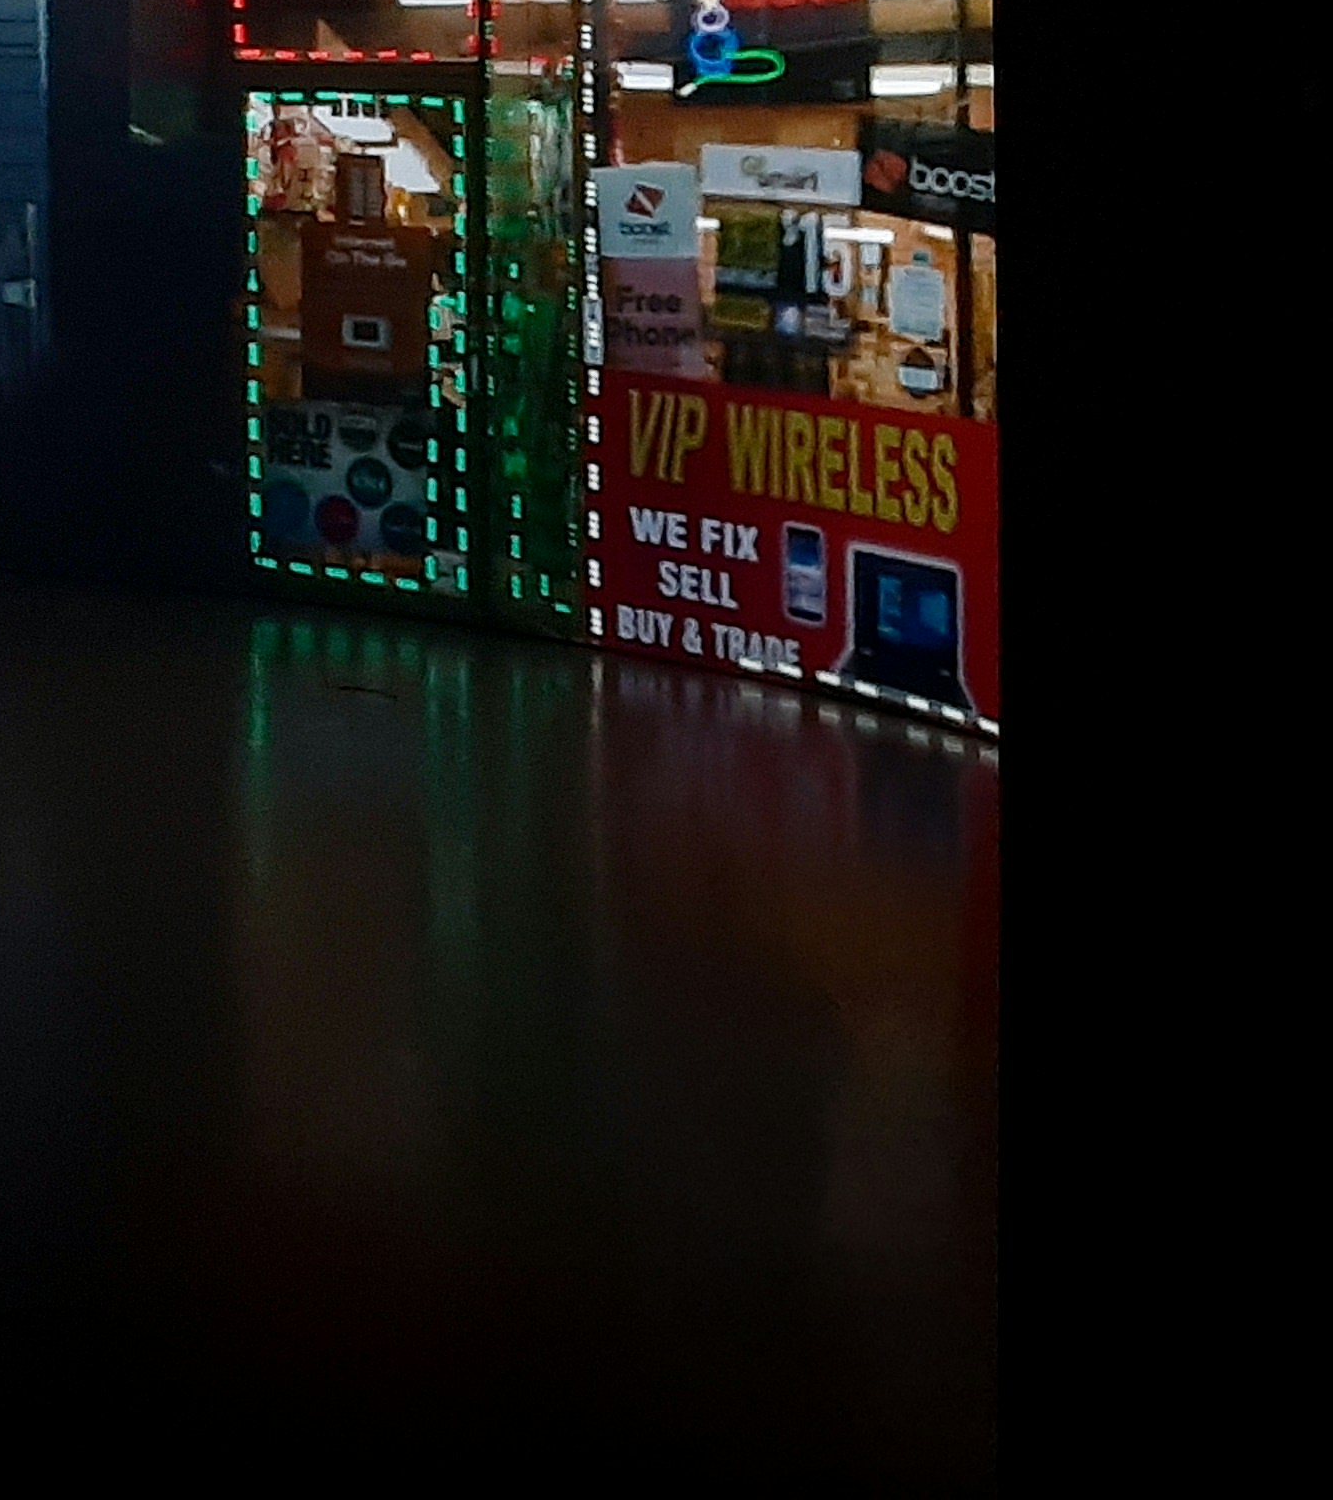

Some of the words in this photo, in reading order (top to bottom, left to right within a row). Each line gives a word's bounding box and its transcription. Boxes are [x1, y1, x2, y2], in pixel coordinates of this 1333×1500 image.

[628, 389, 709, 484] VIP
[726, 402, 959, 534] WIRELESS
[629, 506, 688, 550] WE
[700, 516, 760, 563] FIX
[657, 560, 740, 610] SELL
[616, 604, 675, 648] BUY
[681, 617, 704, 657] &
[711, 622, 803, 668] TRADE
